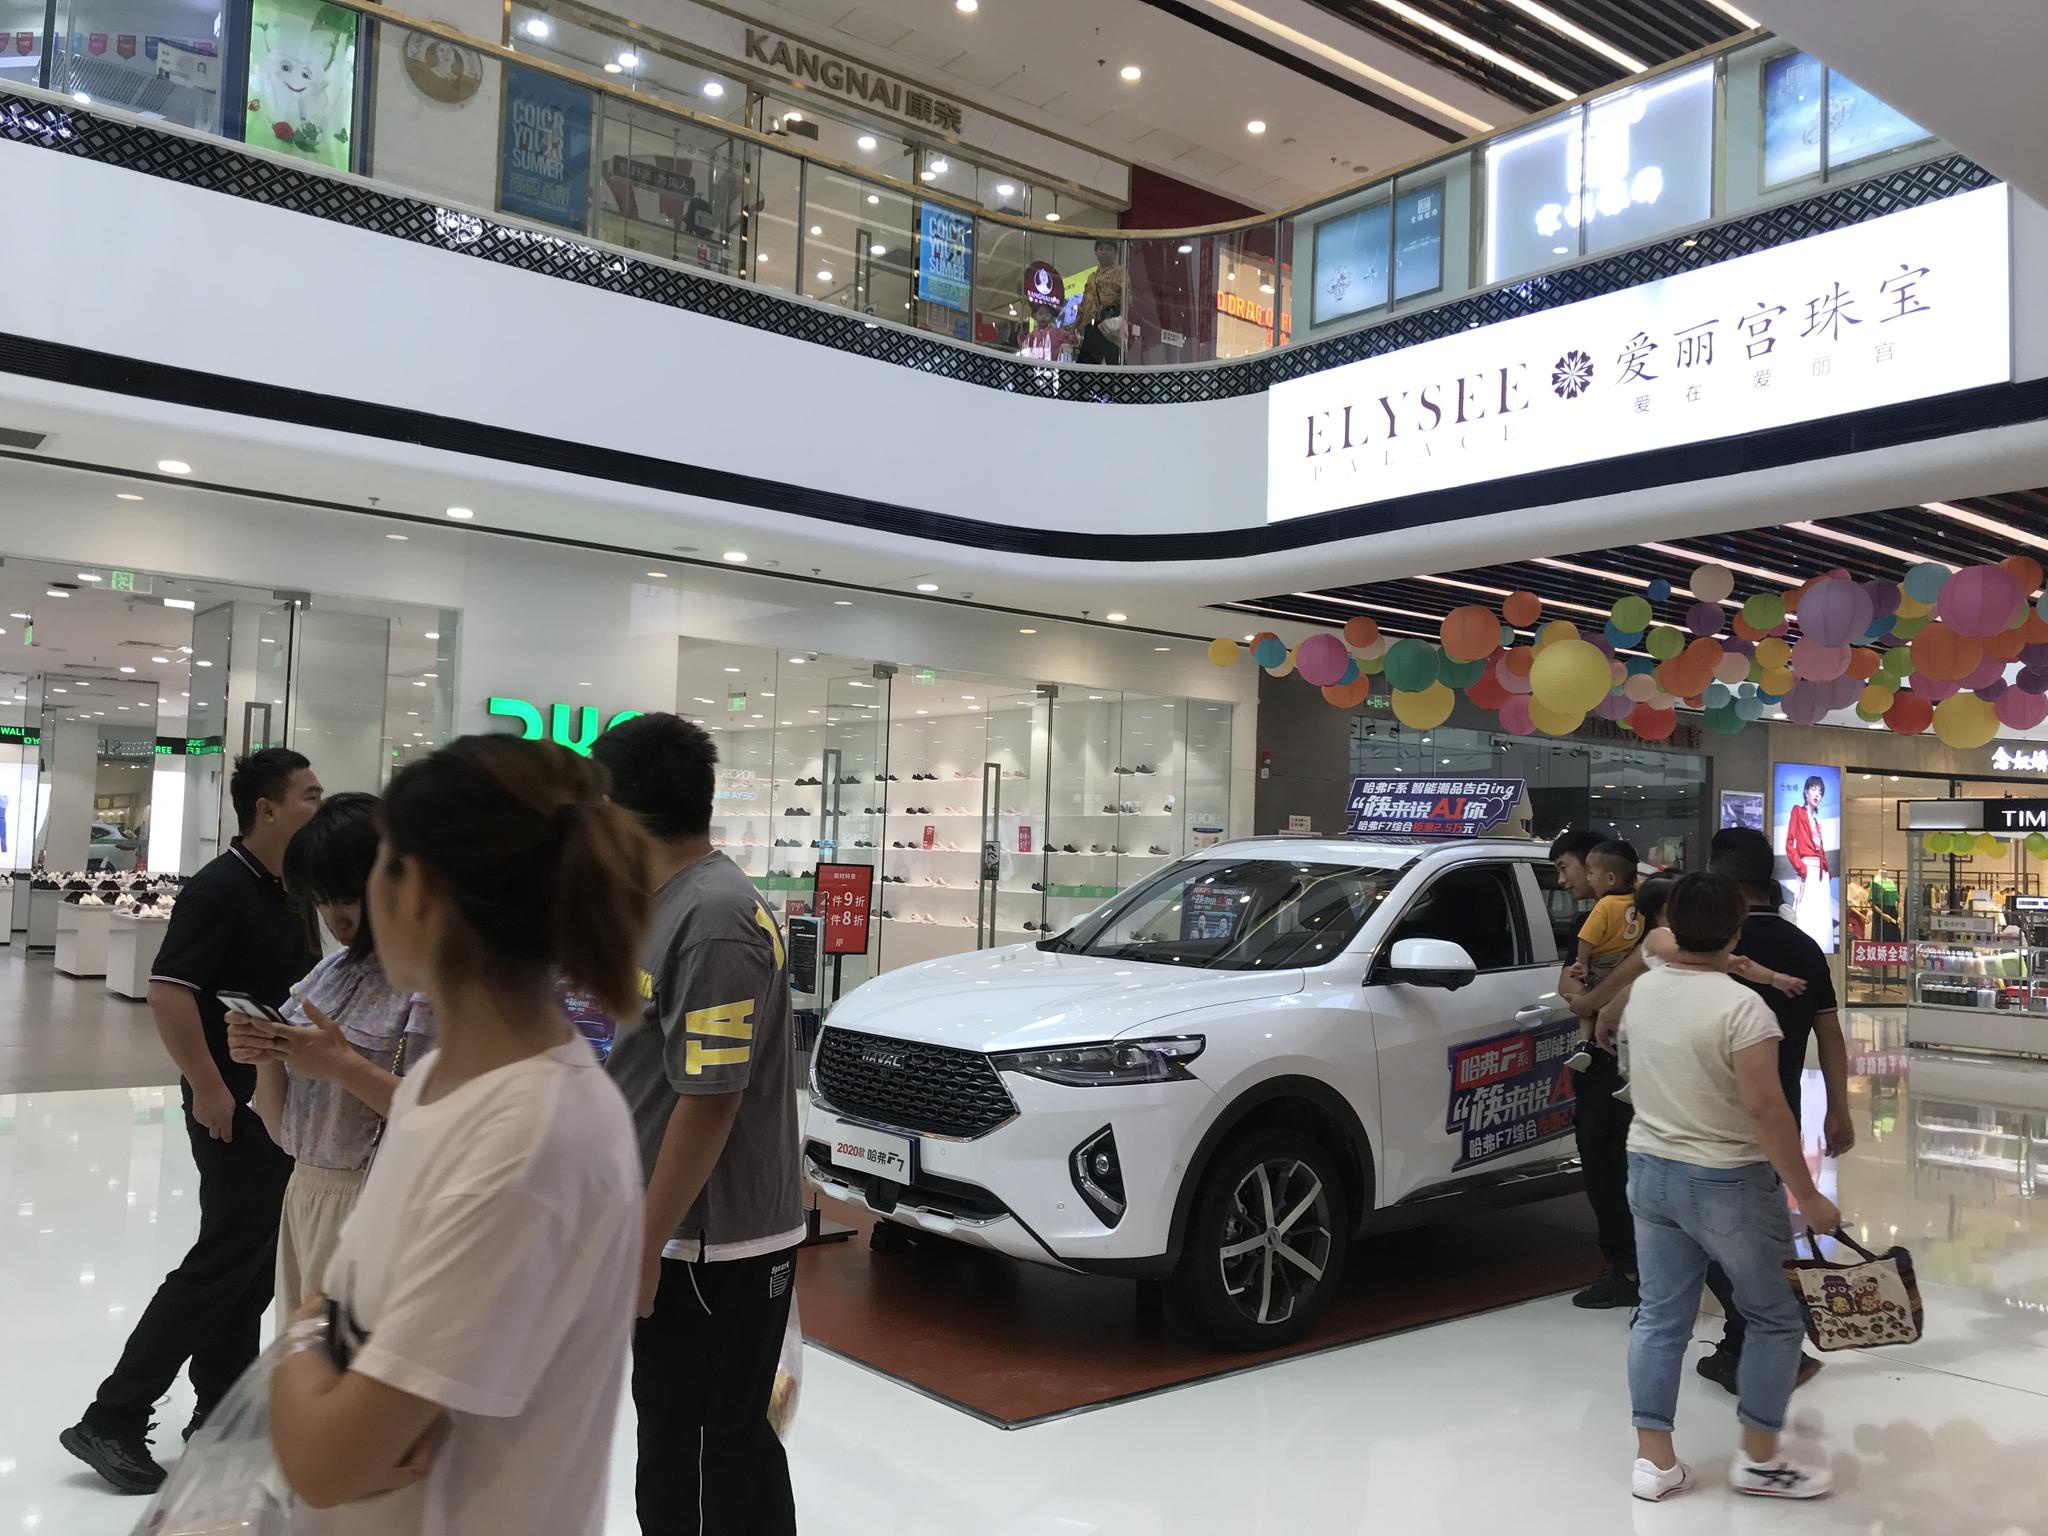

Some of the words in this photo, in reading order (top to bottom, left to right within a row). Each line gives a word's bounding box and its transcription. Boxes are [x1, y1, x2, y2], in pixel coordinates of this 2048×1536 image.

[745, 28, 902, 111] KANGNAI
[511, 147, 565, 181] SUMMER
[928, 256, 965, 282] SUMMER
[1615, 263, 1932, 386] 爱丽宫珠宝
[1306, 363, 1529, 458] ELYSEE
[1633, 341, 1896, 415] 爱在爱丽宫
[1363, 782, 1407, 793] 哈弗F系
[685, 999, 755, 1075] TA
[862, 1049, 902, 1067] HAVAL
